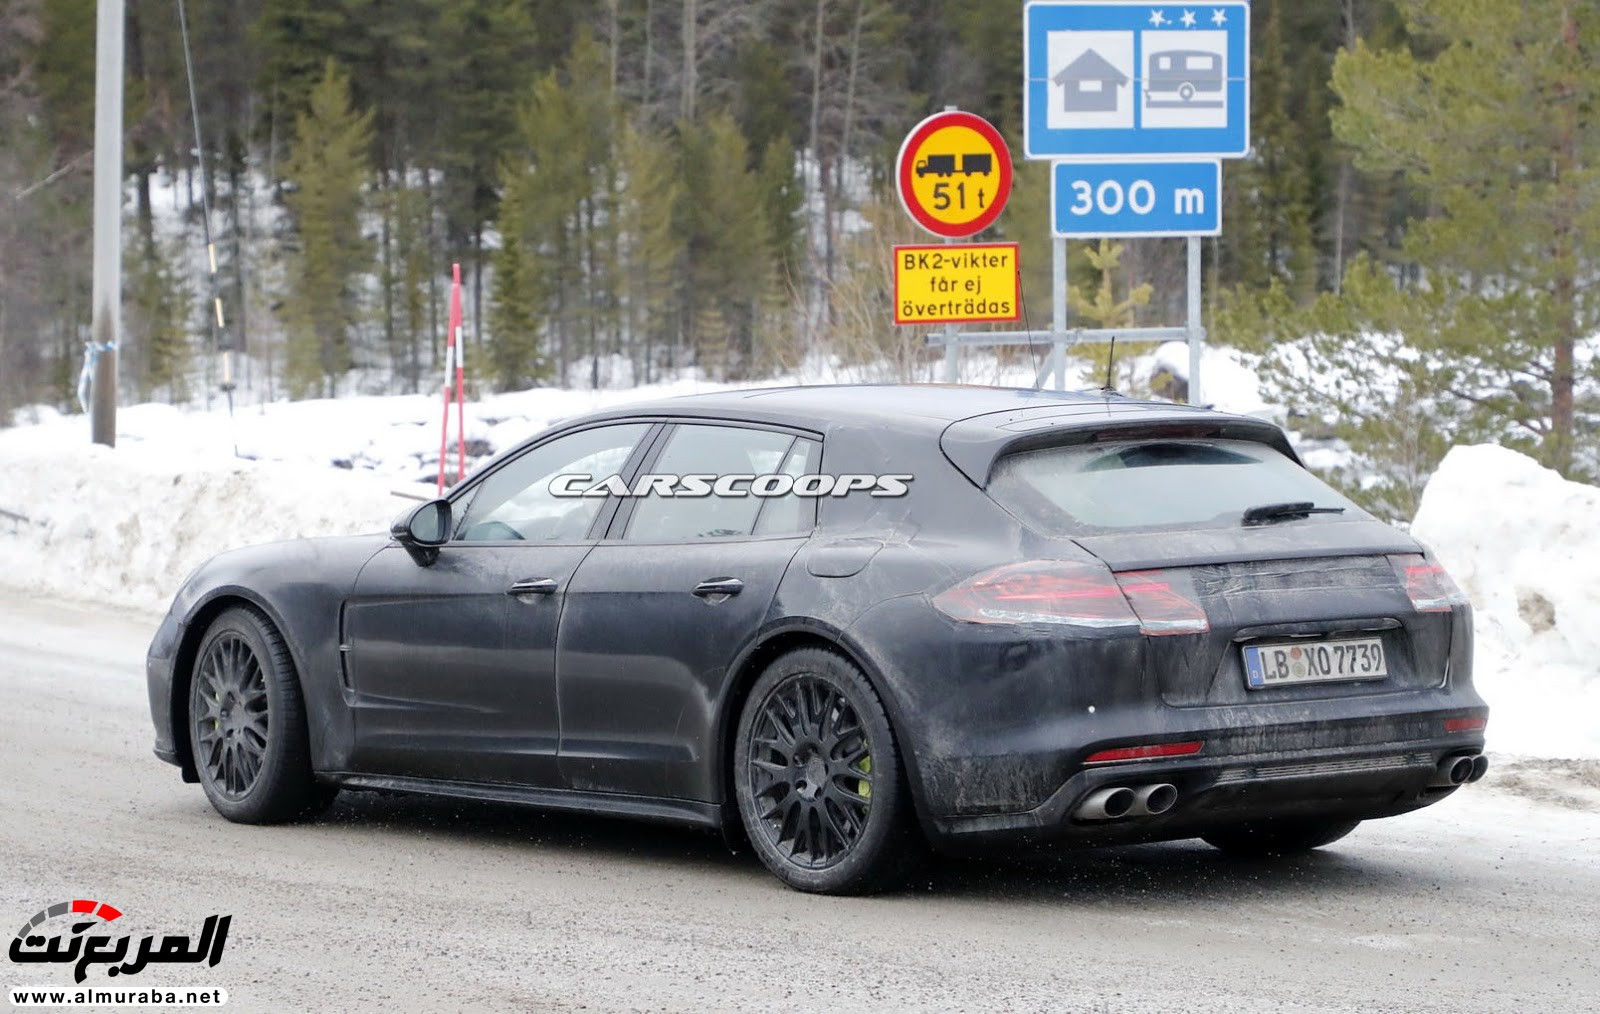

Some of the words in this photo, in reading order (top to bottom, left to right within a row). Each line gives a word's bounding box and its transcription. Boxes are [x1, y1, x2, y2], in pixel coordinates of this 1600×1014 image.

[933, 182, 966, 210] 51
[977, 188, 986, 209] t
[1071, 179, 1156, 215] 300
[1174, 187, 1205, 215] m
[904, 254, 1009, 271] BK2-vikter
[930, 276, 959, 292] får
[965, 279, 982, 294] ej
[903, 300, 1010, 317] överträdas
[1260, 650, 1289, 680] LB
[1333, 643, 1382, 674] 7739
